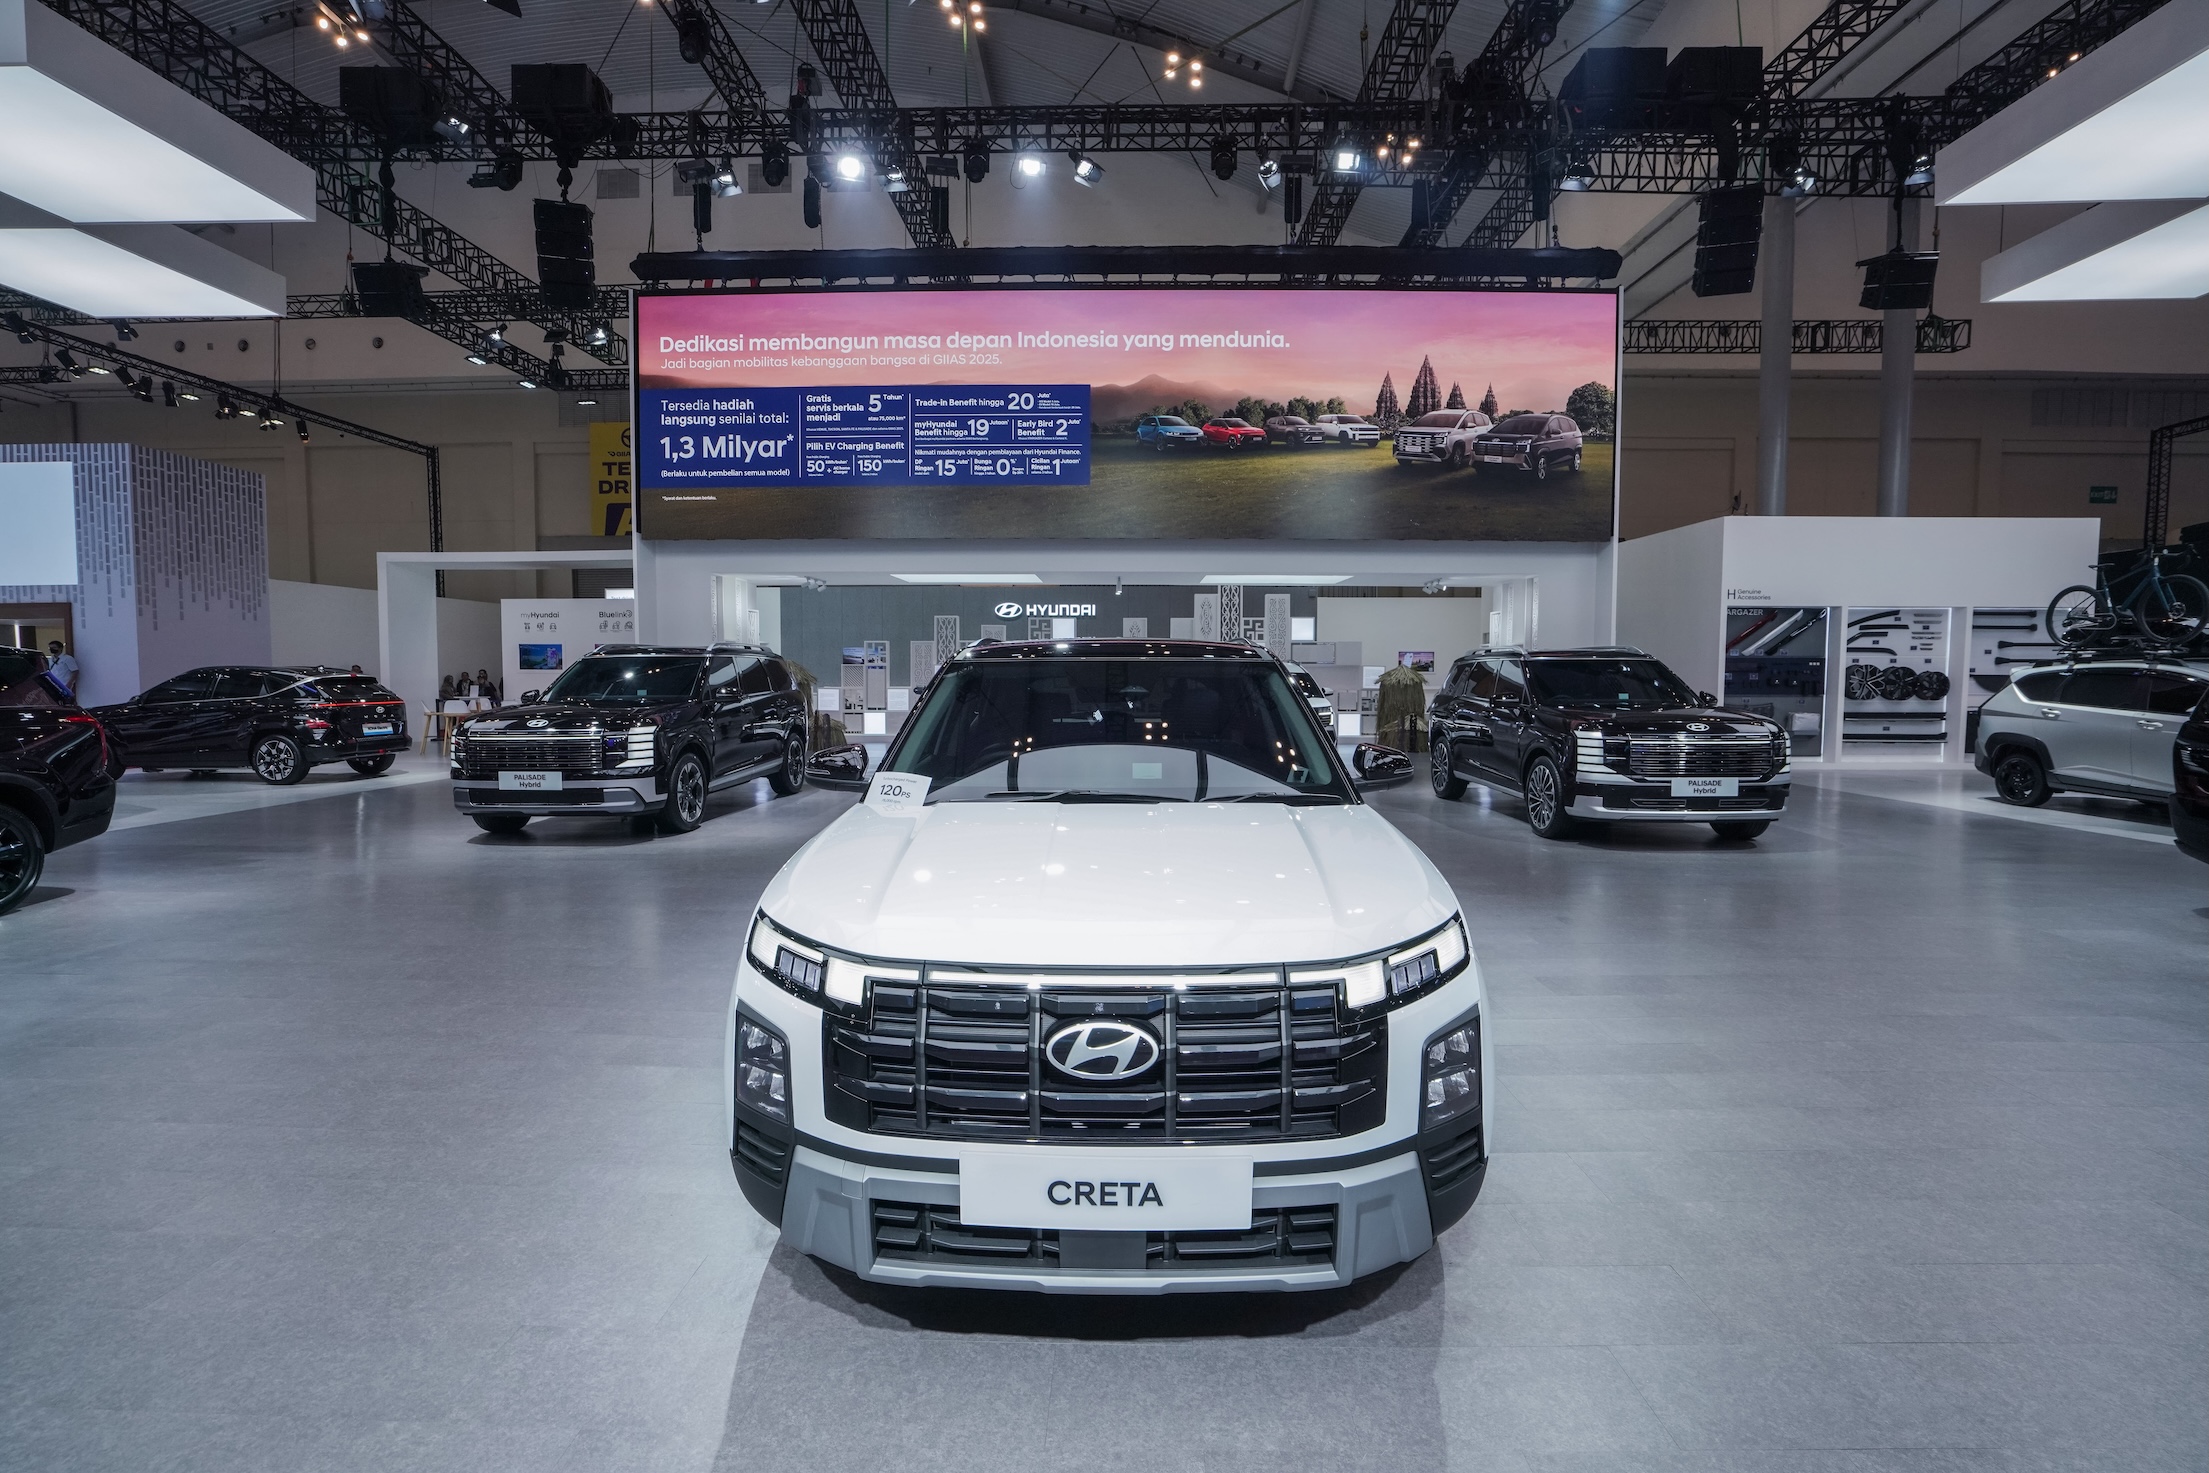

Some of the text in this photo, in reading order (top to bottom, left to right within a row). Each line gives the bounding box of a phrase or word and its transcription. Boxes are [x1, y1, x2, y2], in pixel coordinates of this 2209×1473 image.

[660, 330, 1290, 354] Dedikasi membangun masa depan Indonesia yang mendunia.
[660, 354, 1003, 371] Jadi bagian mobilitas kebanggaan bangsa di GIIAS 2025.
[660, 398, 754, 412] Tersedia hadiah
[806, 394, 832, 402] Gratis
[868, 394, 882, 412] 5
[949, 398, 978, 406] Benefit
[978, 398, 1004, 408] hingga
[1008, 393, 1034, 410] 20
[806, 403, 864, 412] servis berkala
[660, 412, 789, 428] langsung senilai total:
[806, 413, 840, 422] menjadi
[914, 420, 958, 429] myHyundai
[1018, 420, 1036, 428] Early
[943, 428, 968, 437] hingga
[968, 419, 990, 436] 19
[1056, 419, 1068, 436] 2
[660, 436, 695, 464] 1,3
[806, 442, 904, 451] Pilih EV Charging Benefit
[806, 460, 825, 472] 50
[858, 460, 882, 472] 150
[935, 460, 956, 476] 15
[996, 458, 1010, 476] 0
[1052, 458, 1060, 476] 1
[661, 470, 688, 478] (Berlaku
[688, 470, 708, 478] untuk
[708, 470, 744, 478] pembelian
[767, 469, 790, 478] model)
[1026, 604, 1096, 616] HYUNDAI
[1047, 1180, 1164, 1207] CRETA
